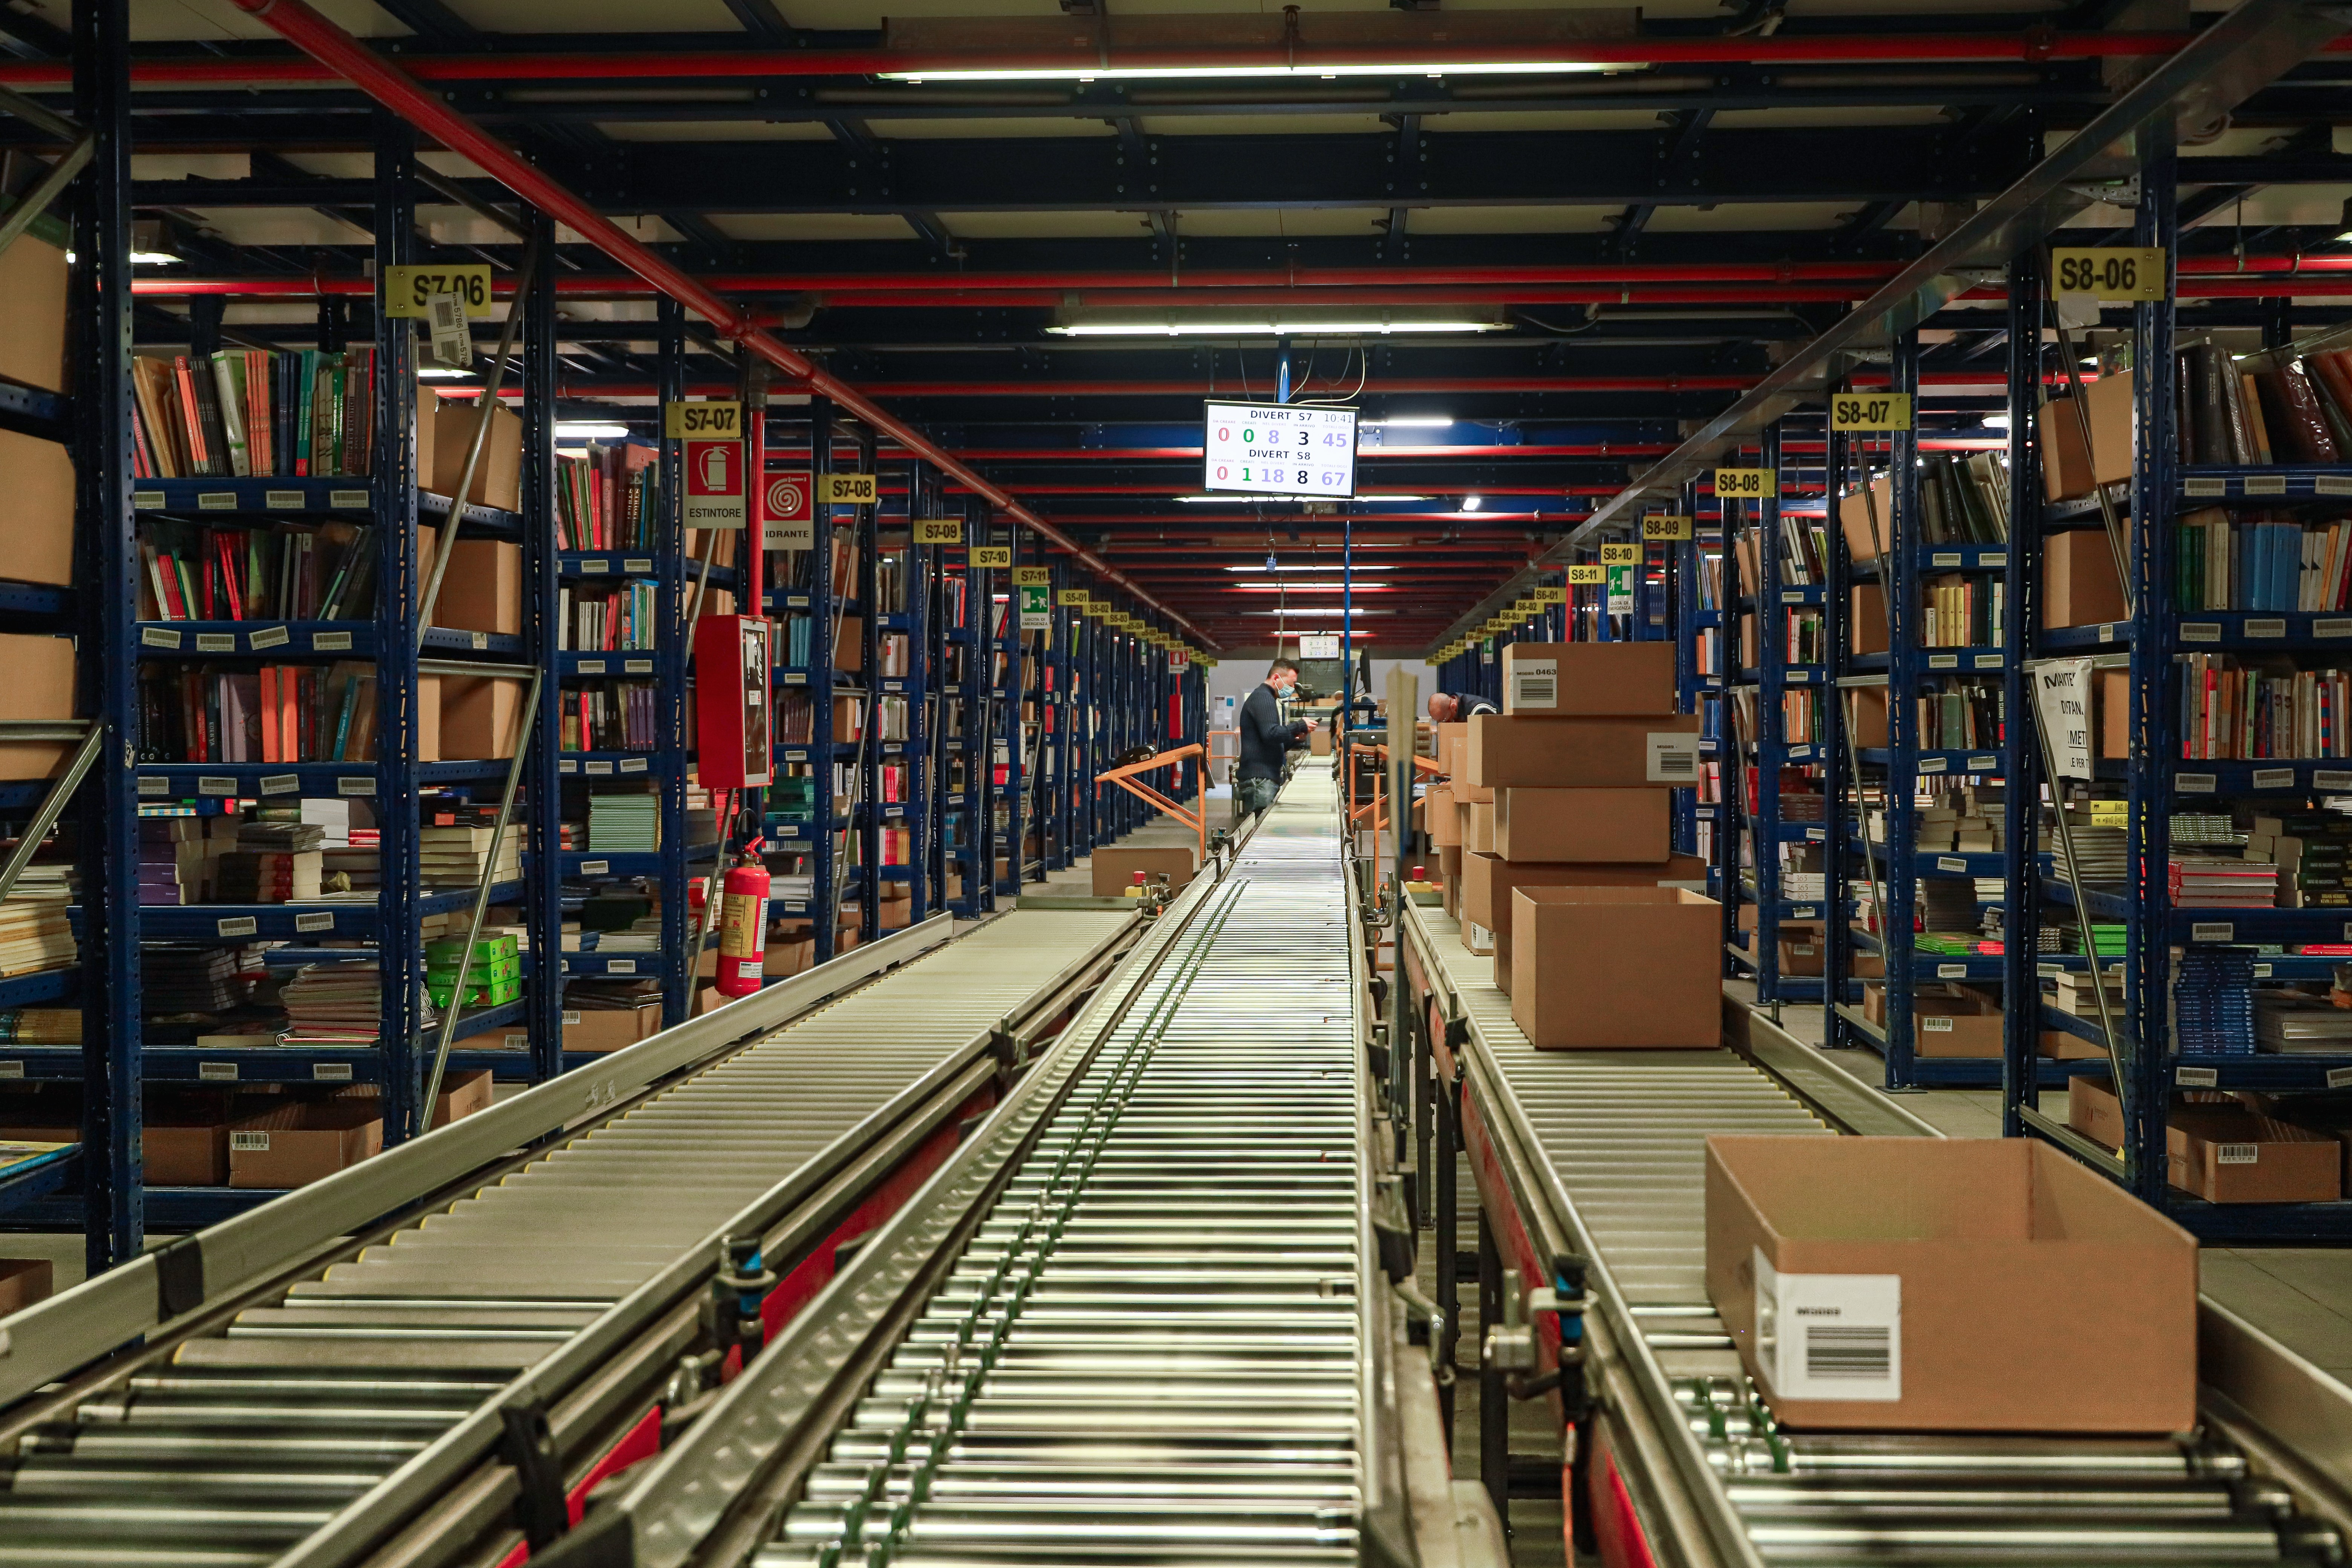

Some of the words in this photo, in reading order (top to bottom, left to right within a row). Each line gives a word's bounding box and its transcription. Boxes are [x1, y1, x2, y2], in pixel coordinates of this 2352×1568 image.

[2060, 258, 2136, 290] S8-06
[413, 275, 484, 306] S7-06
[454, 307, 463, 328] 5786
[684, 408, 735, 430] S7-07
[1251, 410, 1291, 420] DIVERT
[1325, 413, 1352, 423] 10:41
[1837, 401, 1889, 424] S8-07
[1219, 428, 1229, 441] 0
[1243, 429, 1254, 443] 0
[1268, 430, 1279, 444] 8
[1298, 432, 1309, 445] 3
[1323, 433, 1346, 447] 45
[1250, 450, 1289, 459] DIVERT
[1217, 466, 1228, 480] 0
[1243, 468, 1252, 481] 1
[1262, 469, 1284, 483] 18
[1297, 470, 1308, 484] 8
[1322, 472, 1346, 486] 67
[833, 480, 872, 498] S7-08
[1719, 474, 1759, 492] S8-08
[689, 508, 741, 518] ESTINTORE
[925, 524, 957, 538] S7-09
[1646, 520, 1679, 534] S8-09
[980, 551, 1008, 563] S7-10
[1604, 548, 1632, 560] S8-10
[1021, 570, 1046, 581] S7-11
[1572, 569, 1597, 580] S8-11
[1066, 593, 1087, 602] S5-01
[1536, 591, 1558, 599] S6-01
[1090, 604, 1109, 612] S5-02
[2070, 730, 2087, 745] MET
